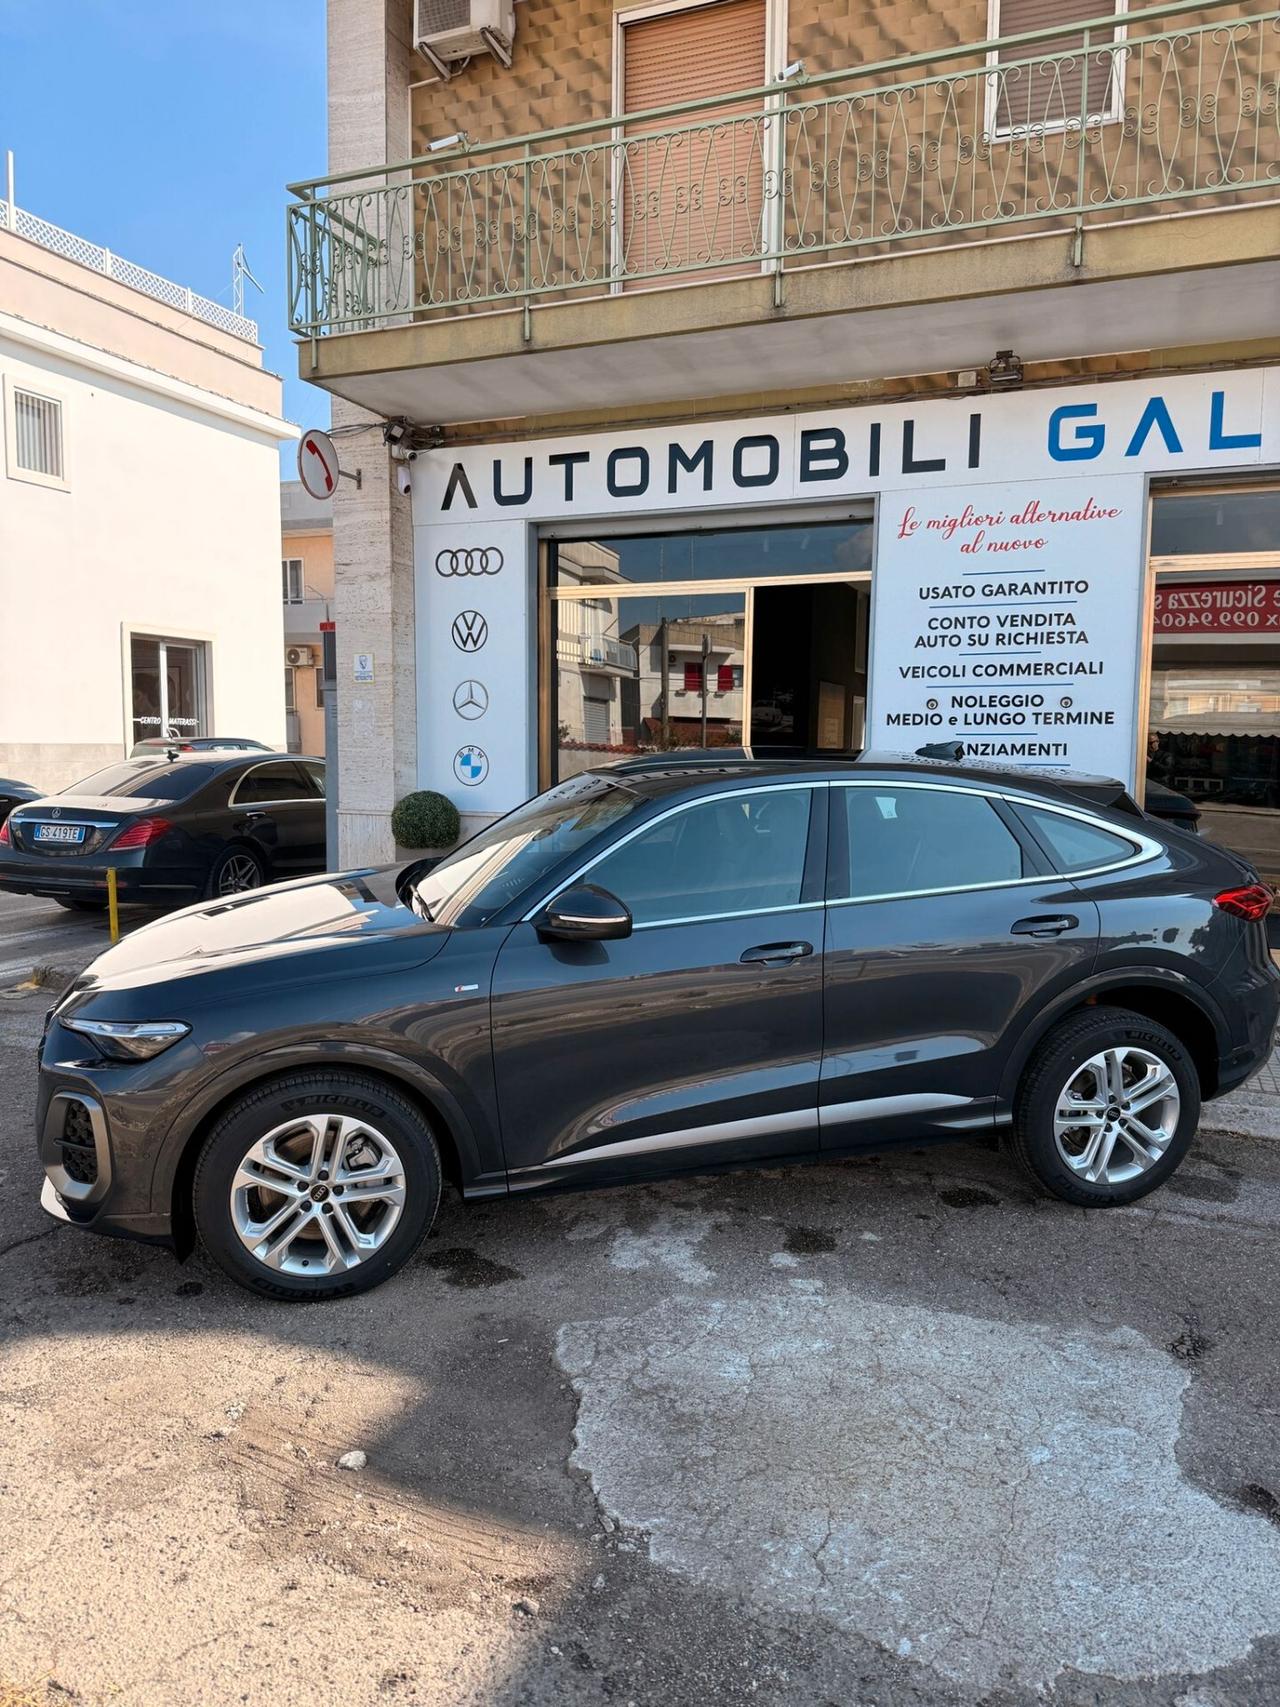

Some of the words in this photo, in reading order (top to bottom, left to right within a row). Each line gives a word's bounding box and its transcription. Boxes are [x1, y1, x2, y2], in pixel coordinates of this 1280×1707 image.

[441, 413, 981, 511] AUTOMOBILI
[1048, 391, 1262, 462] GAL
[897, 506, 921, 539] Le
[926, 505, 1005, 540] migliori
[1010, 497, 1122, 525] alternative
[960, 530, 986, 554] al
[987, 537, 1048, 553] nuovo
[919, 585, 975, 600] USATO
[981, 580, 1089, 598] GARANTITO
[928, 616, 990, 631] CONTO
[996, 613, 1076, 628] VENDITA
[914, 634, 961, 648] AUTO
[967, 633, 989, 647] SU
[995, 631, 1089, 646] RICHIESTA
[899, 665, 966, 679] VEICOLI
[972, 661, 1104, 677] COMMERCIALI
[951, 694, 1044, 709] NOLEGGIO
[140, 716, 161, 725] CENTRO
[886, 713, 942, 726] MEDIO
[948, 715, 958, 726] e
[963, 712, 1026, 726] LUNGO
[1032, 711, 1114, 725] TERMINE
[926, 742, 1067, 757] NZIAMENTI
